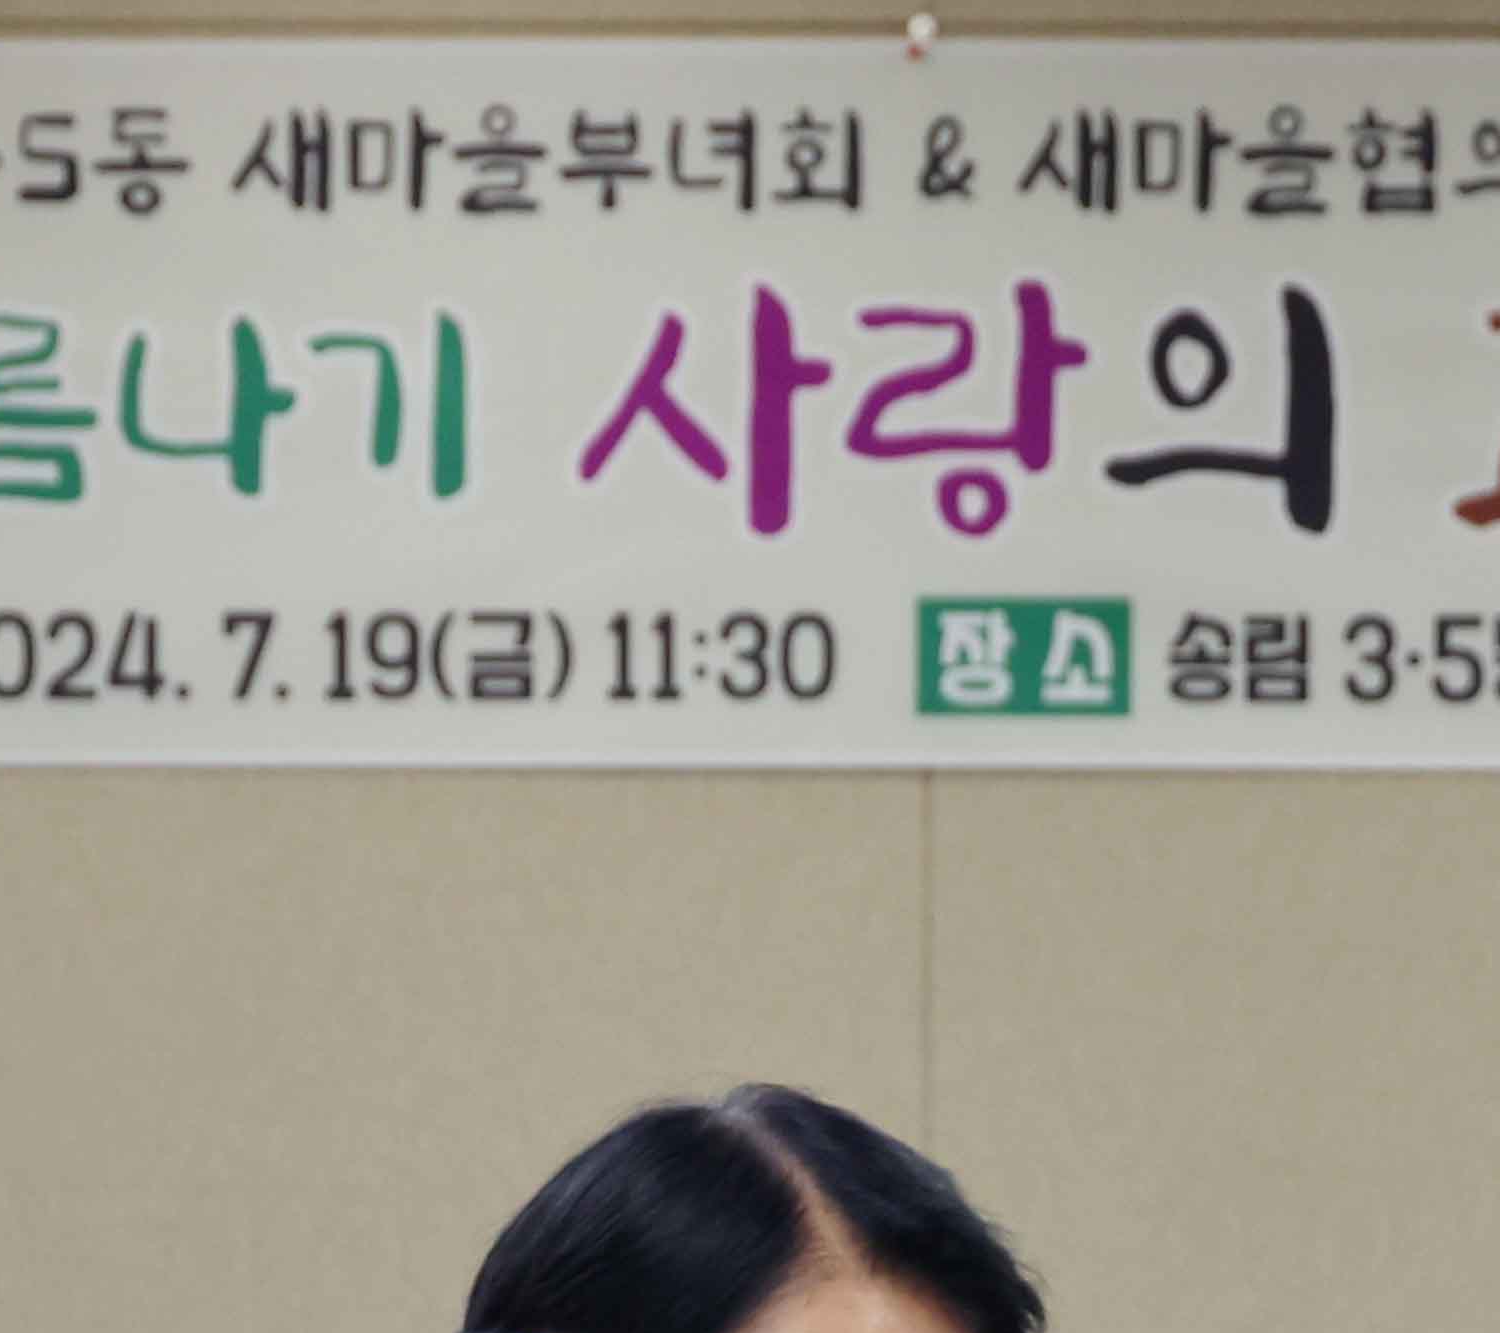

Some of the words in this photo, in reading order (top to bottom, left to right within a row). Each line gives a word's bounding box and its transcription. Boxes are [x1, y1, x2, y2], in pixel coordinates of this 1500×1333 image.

[232, 114, 862, 213] 새마을부녀회
[918, 117, 974, 199] &
[580, 283, 1336, 537] 사랑의
[610, 614, 835, 701] 11:30
[1169, 615, 1310, 703] 송림
